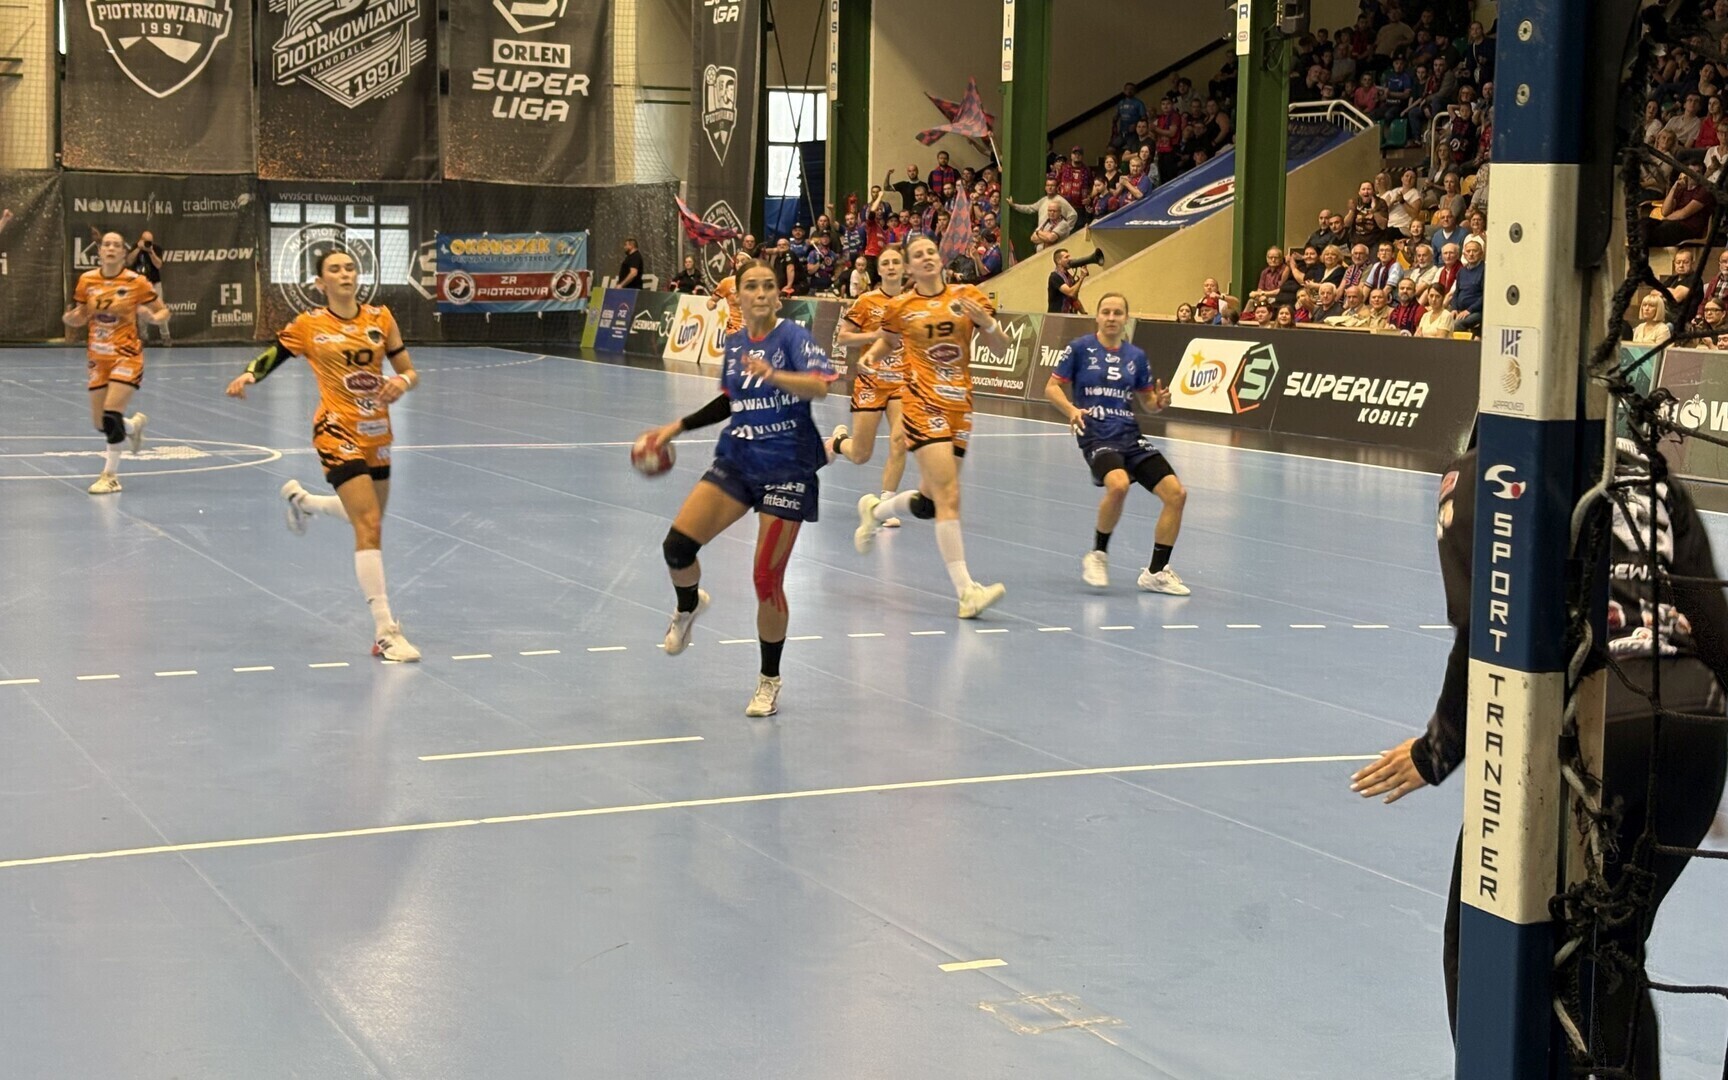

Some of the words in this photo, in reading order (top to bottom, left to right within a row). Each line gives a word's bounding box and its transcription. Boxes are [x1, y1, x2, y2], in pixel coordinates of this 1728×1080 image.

[98, 4, 223, 29] PIOTRKOWIANIN
[141, 22, 184, 36] 1997
[277, 0, 417, 74] PIOTRKOWIANIN
[311, 42, 366, 75] HANDBALL
[498, 43, 566, 64] ORLEN
[353, 54, 399, 97] 1997
[471, 68, 591, 97] SUPER
[492, 96, 570, 122] LIGA
[182, 196, 236, 211] tradimex
[315, 194, 375, 203] EWAKUACYJNE
[450, 238, 551, 255] OKRUSZEK
[477, 287, 549, 297] PIOTRCOVIA
[95, 299, 113, 310] 17
[677, 322, 698, 345] LOTTO
[925, 321, 955, 339] 19
[342, 349, 373, 366] 10
[1106, 366, 1122, 380] 5
[1190, 367, 1218, 388] LOTTO
[1283, 371, 1429, 408] SUPERLIGA
[1492, 400, 1525, 411] APPROVED
[1357, 408, 1419, 428] KOBIET
[1489, 512, 1513, 653] SPORT
[1480, 673, 1505, 902] TRANSFER
